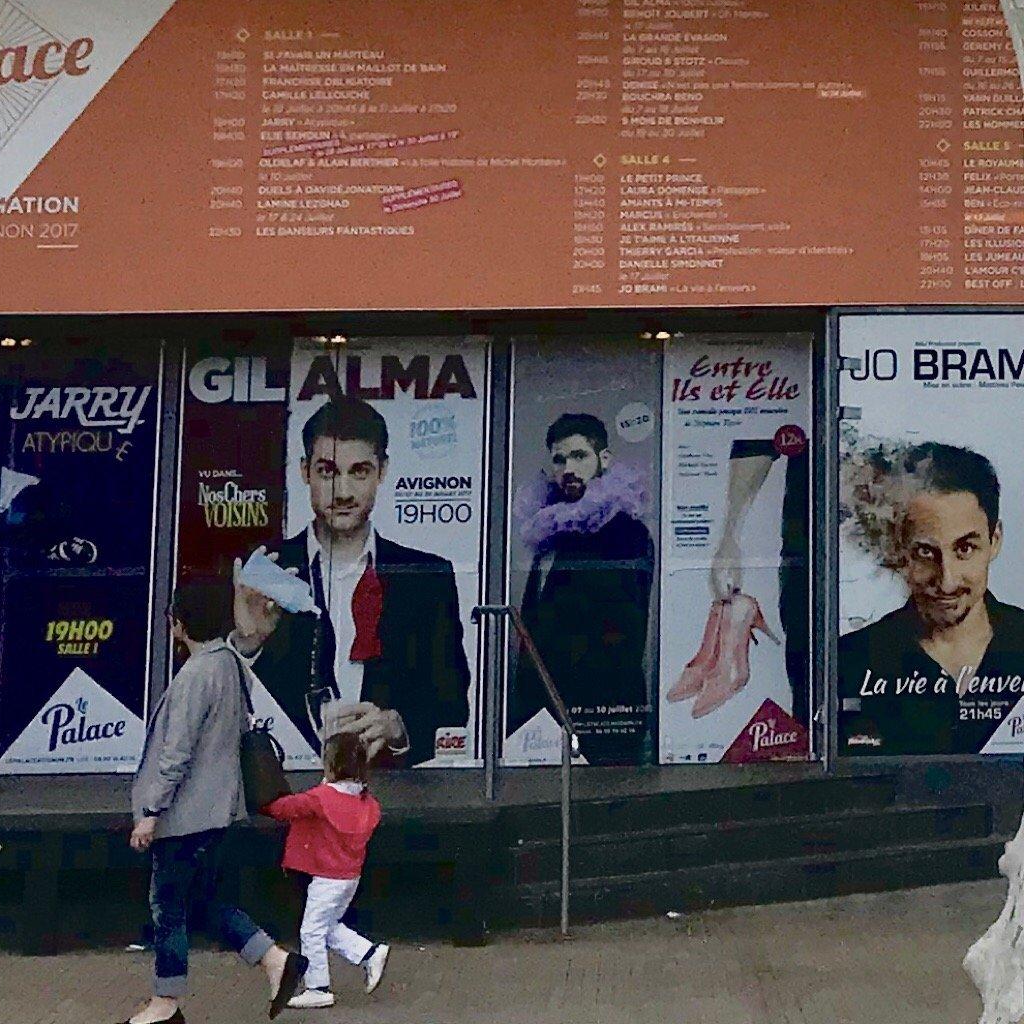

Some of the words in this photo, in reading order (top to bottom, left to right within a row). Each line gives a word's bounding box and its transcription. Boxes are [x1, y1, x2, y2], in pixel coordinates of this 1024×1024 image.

[621, 155, 659, 164] SALLE
[38, 222, 78, 238] 2017
[689, 354, 773, 379] Entre
[849, 349, 898, 381] JO
[188, 355, 287, 404] GIL
[296, 354, 477, 401] ALMA
[710, 380, 742, 403] et
[745, 377, 801, 402] Elle
[10, 385, 153, 435] JARRY
[395, 476, 472, 490] AVIGNON
[203, 501, 269, 528] VOISINS
[394, 503, 472, 524] 19H00
[46, 618, 115, 642] 19H00
[860, 669, 888, 696] La
[895, 670, 928, 695] vie
[933, 669, 951, 694] à
[959, 707, 1003, 721] 21h45
[41, 703, 126, 752] Palace
[748, 721, 798, 752] Palace
